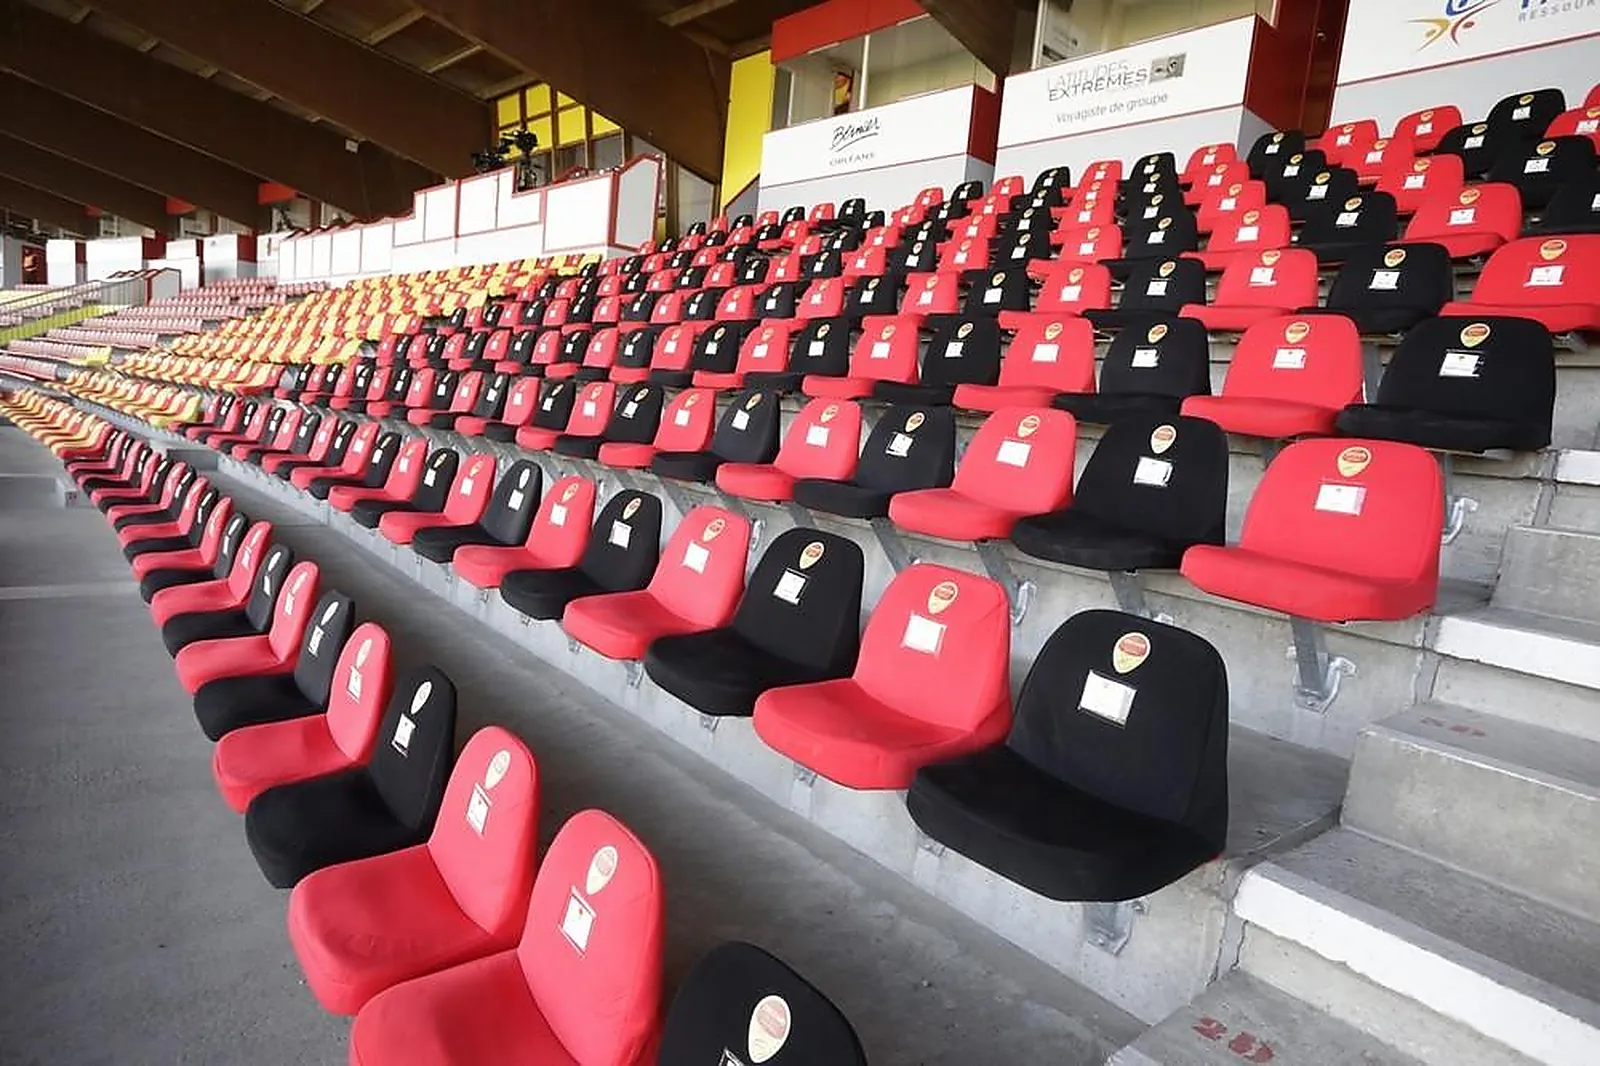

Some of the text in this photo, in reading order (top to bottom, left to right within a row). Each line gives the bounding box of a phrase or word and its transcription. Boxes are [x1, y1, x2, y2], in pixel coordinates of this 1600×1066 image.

[1049, 68, 1148, 101] EXTREMES
[1056, 92, 1168, 123] Voyagiste de groupe
